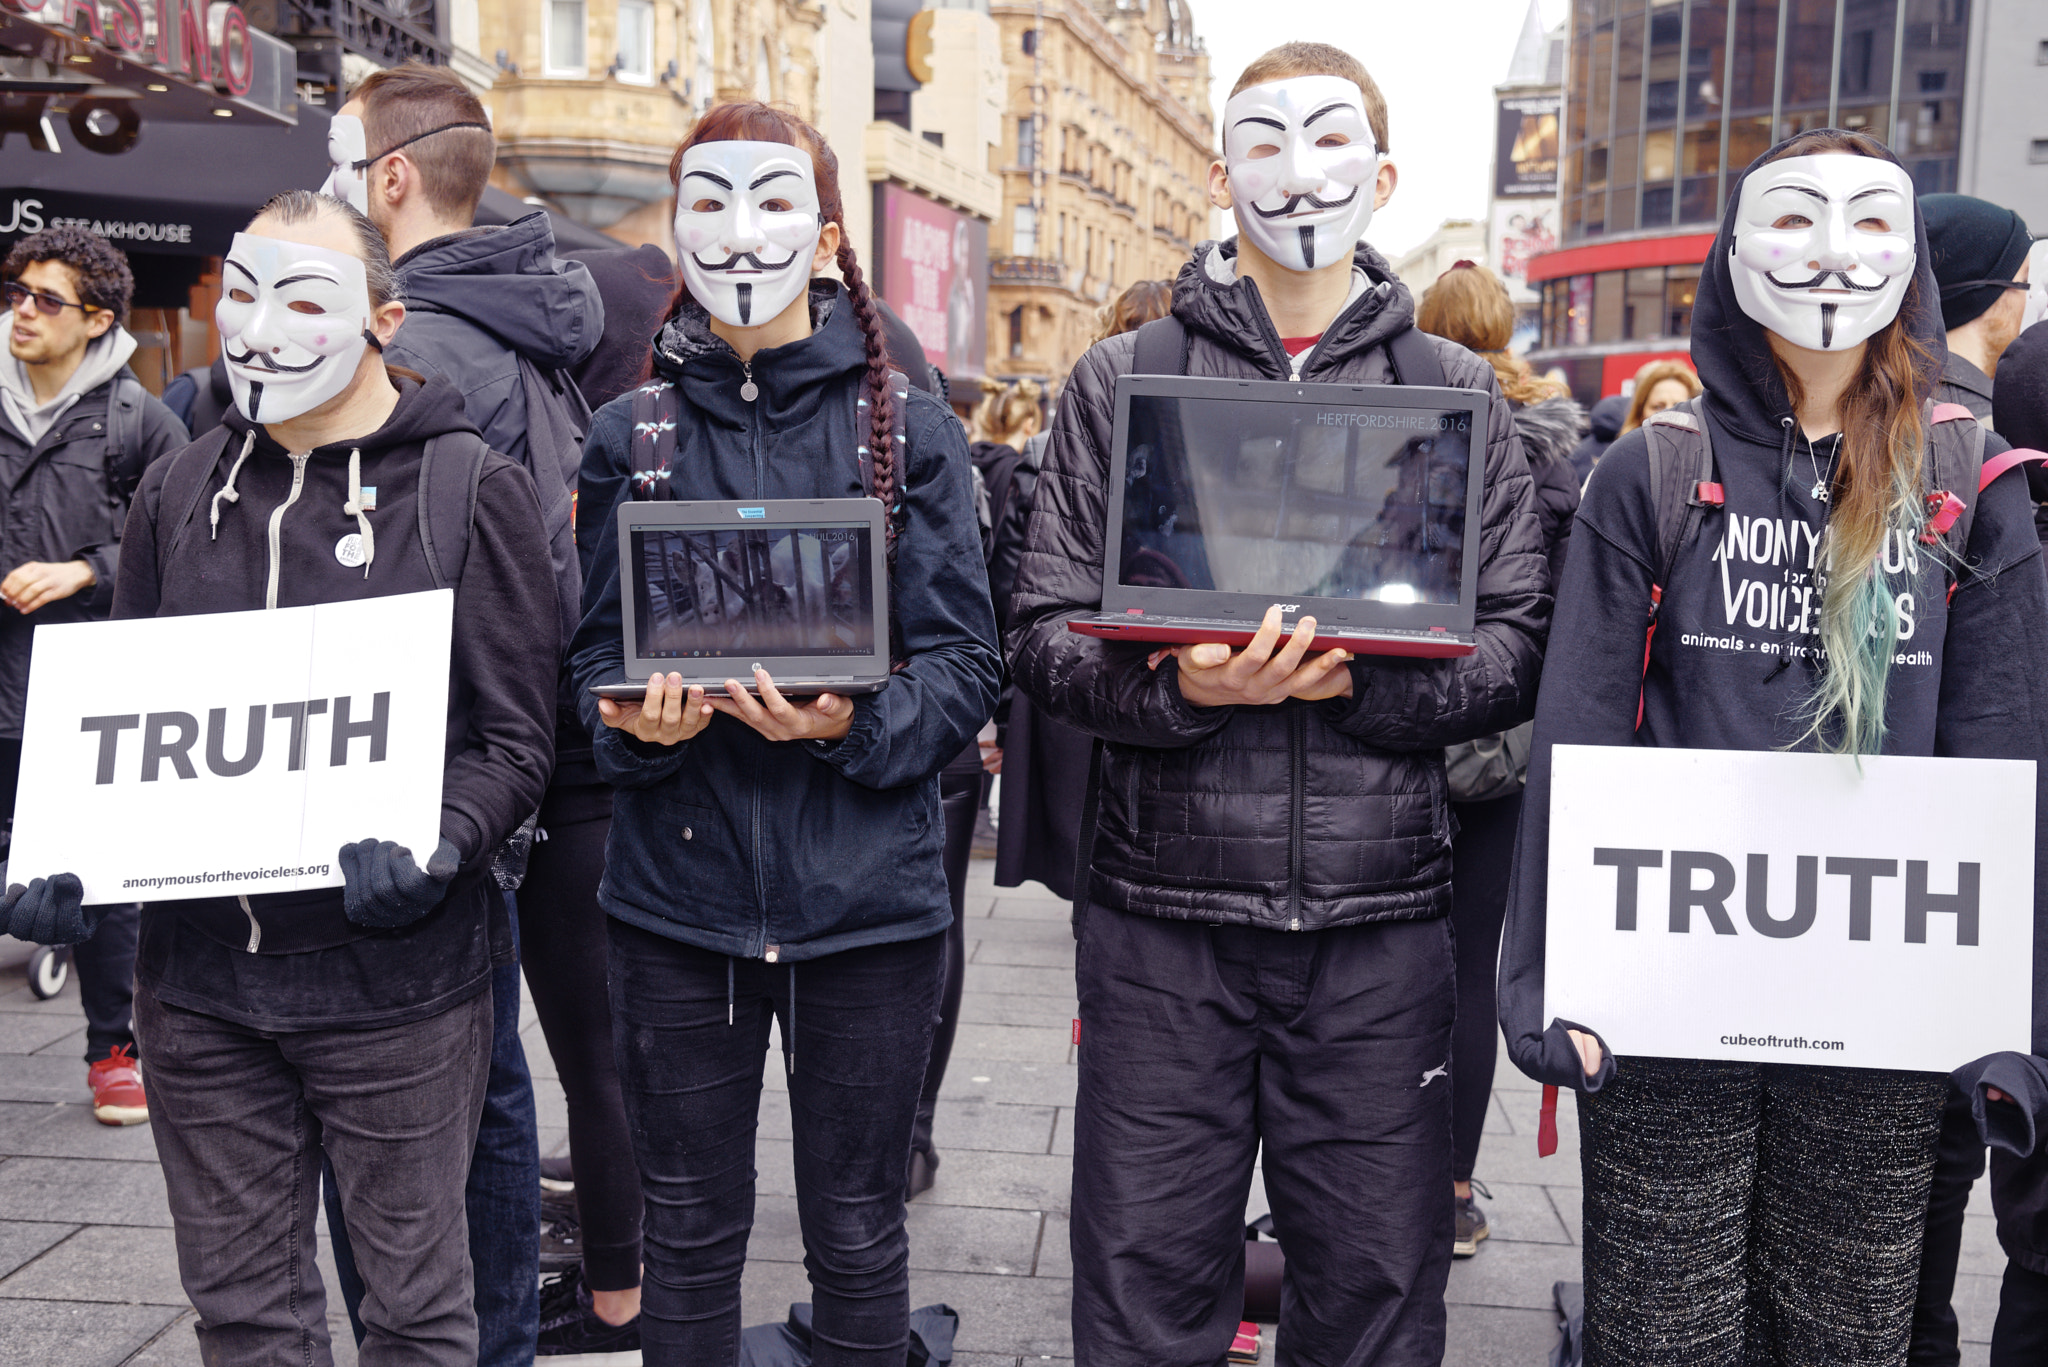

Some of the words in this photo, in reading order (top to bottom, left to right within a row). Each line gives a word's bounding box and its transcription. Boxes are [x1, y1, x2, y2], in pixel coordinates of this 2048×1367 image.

[18, 0, 253, 96] ASINO
[50, 217, 191, 243] STEAKHOUSE
[1712, 513, 1918, 575] ANONYUS
[1681, 632, 1744, 651] animals
[80, 691, 391, 785] TRUTH
[122, 864, 330, 889] anonymousforthevoiceless.org
[1593, 847, 1981, 947] TRUTH
[1720, 1033, 1845, 1051] cubeoftruth.com
